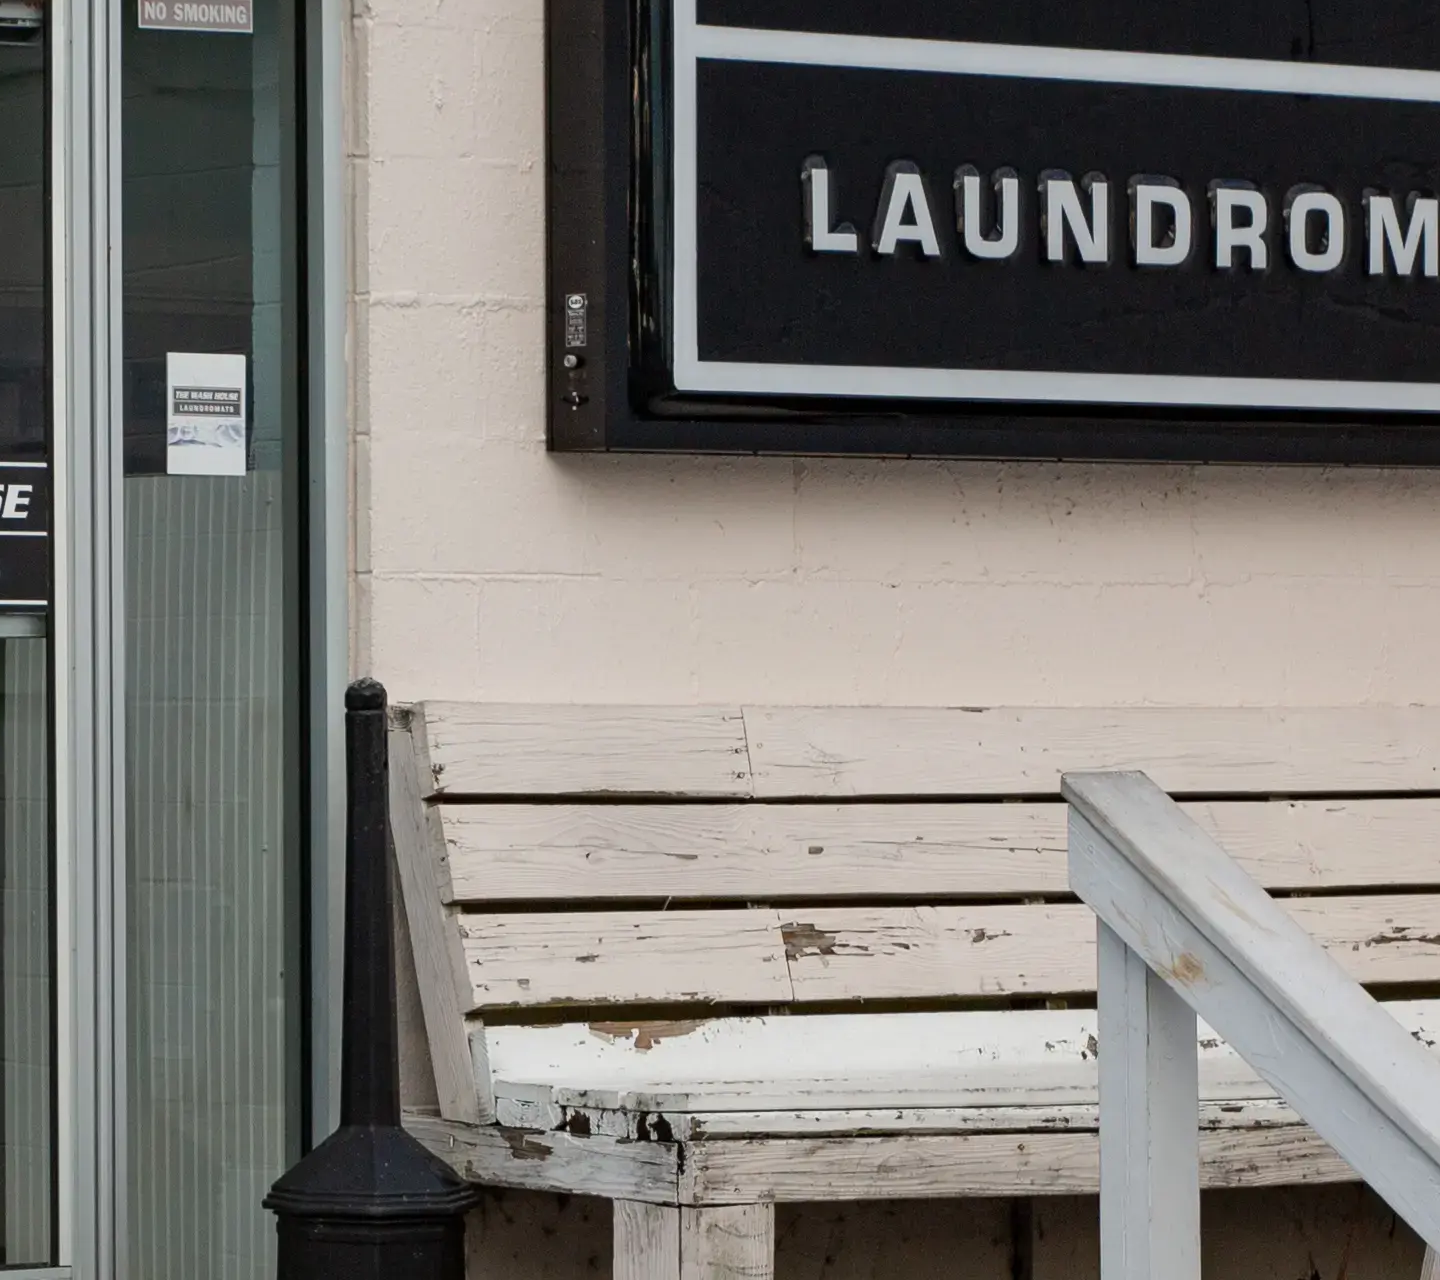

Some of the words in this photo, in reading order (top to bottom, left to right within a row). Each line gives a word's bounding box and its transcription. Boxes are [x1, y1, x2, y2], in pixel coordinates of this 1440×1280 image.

[143, 0, 167, 21] NO
[172, 2, 248, 25] SMOKING
[179, 403, 235, 413] LAUNDROMATS
